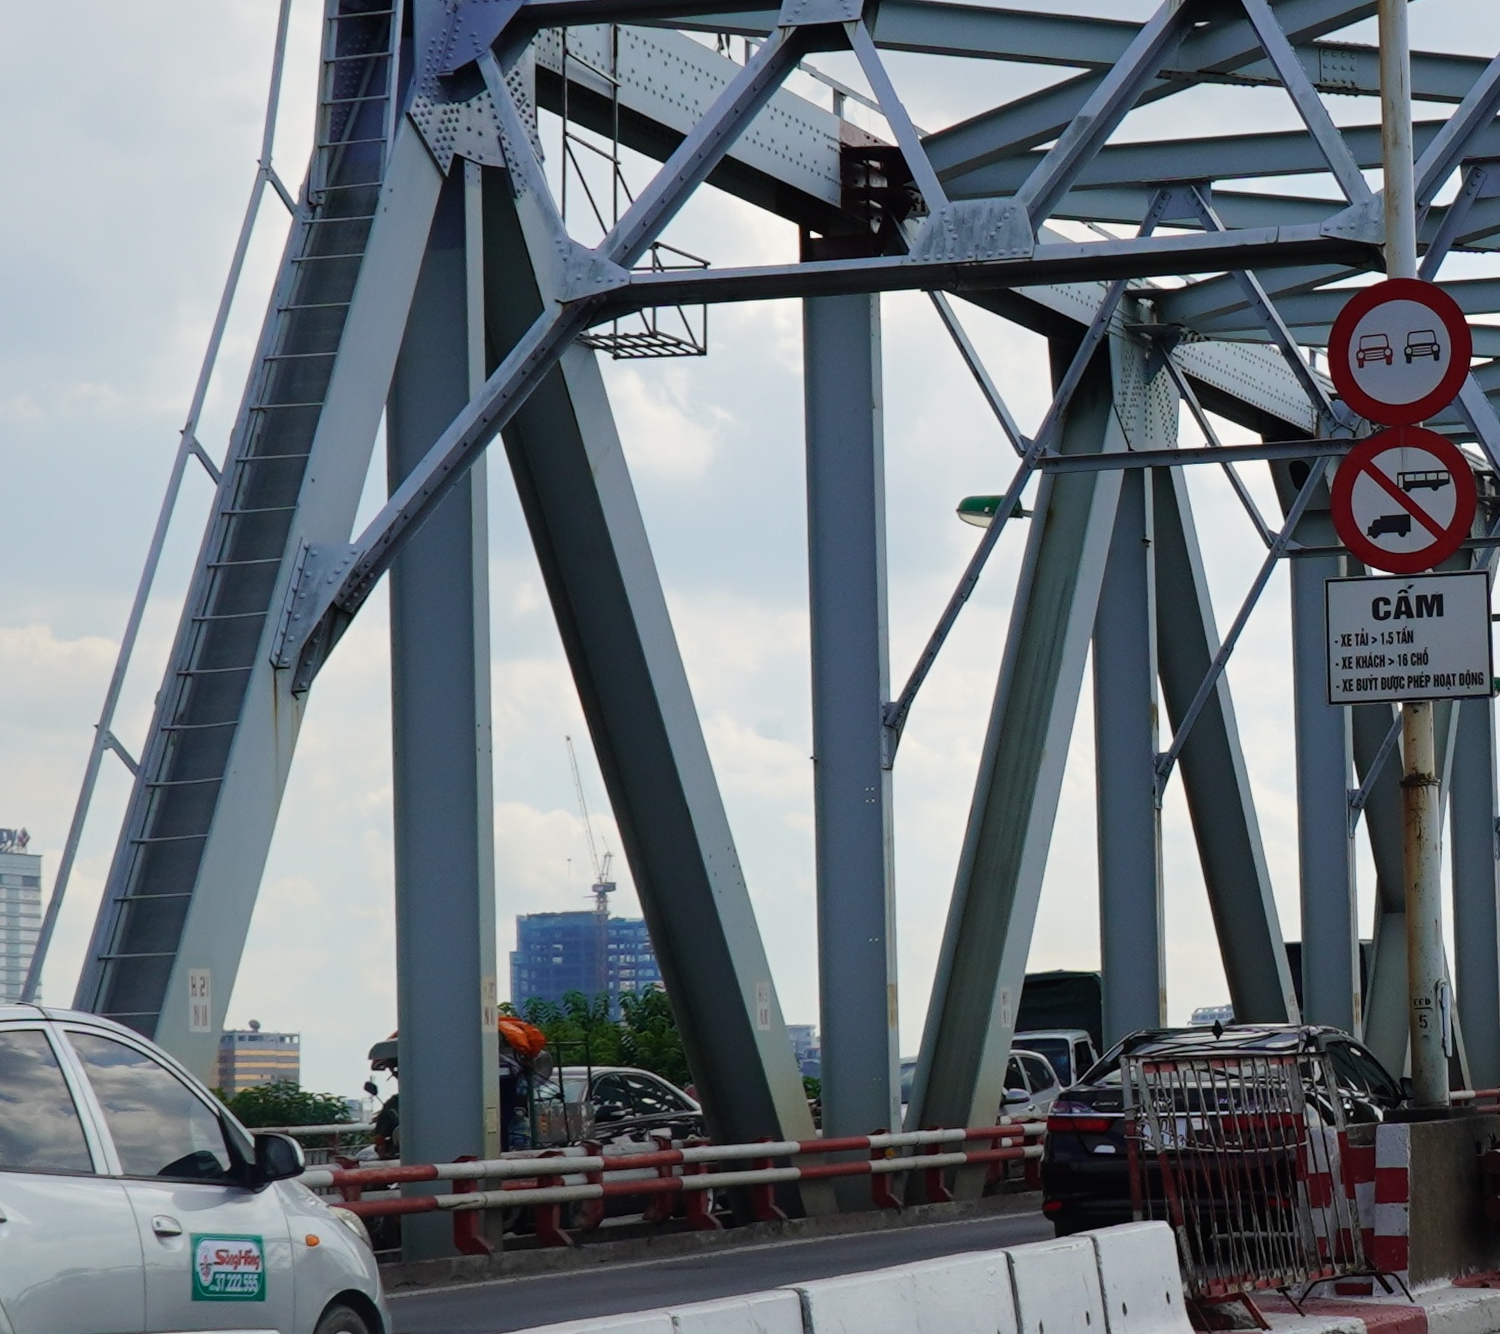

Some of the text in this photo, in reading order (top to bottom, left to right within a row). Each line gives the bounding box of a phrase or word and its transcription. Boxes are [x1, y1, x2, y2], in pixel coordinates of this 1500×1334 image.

[1372, 584, 1444, 621] CẤM
[1340, 634, 1352, 648] XE
[1341, 656, 1353, 670] XE
[1355, 652, 1386, 670] KHÁCH
[1397, 654, 1408, 667] 16
[1342, 678, 1354, 692] XE
[1433, 672, 1457, 691] HOẠT
[1419, 1014, 1428, 1029] 5
